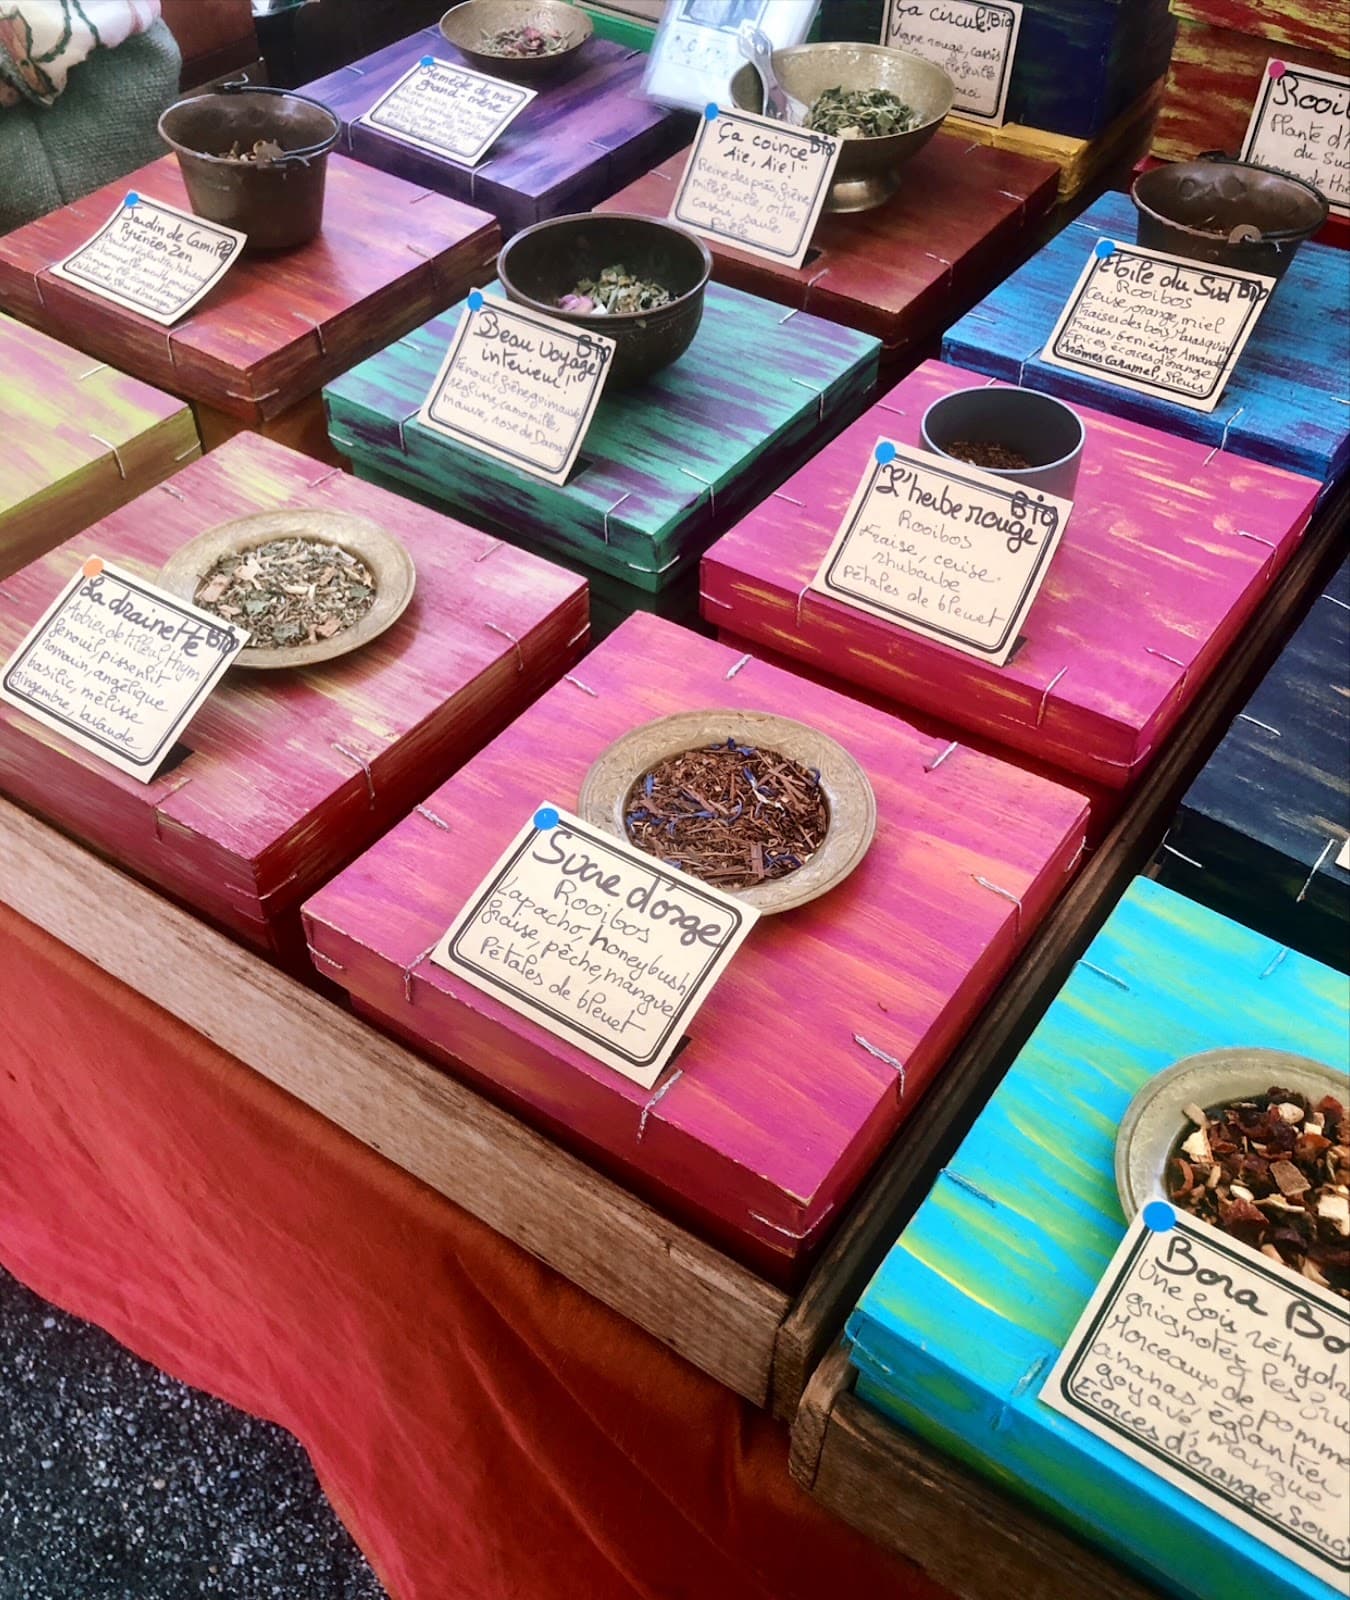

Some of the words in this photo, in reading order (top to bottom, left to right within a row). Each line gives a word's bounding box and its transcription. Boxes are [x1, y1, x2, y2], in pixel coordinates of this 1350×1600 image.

[991, 11, 1014, 28] Bio
[474, 83, 491, 98] de
[752, 136, 808, 162] coince
[1294, 145, 1318, 161] du
[166, 219, 184, 242] de
[168, 244, 193, 262] Zen
[1116, 280, 1193, 309] Rooibos
[1160, 266, 1189, 292] du
[1194, 275, 1236, 303] Sud
[1120, 314, 1141, 329] des
[1182, 317, 1225, 334] miel
[539, 340, 597, 381] Voyage
[576, 334, 611, 363] Bio
[1010, 490, 1059, 527] Bio
[898, 510, 972, 550] Rooibos
[80, 576, 106, 606] La
[907, 587, 928, 609] de
[938, 596, 1006, 627] bleuet
[106, 622, 124, 642] de
[532, 829, 620, 898] Sucre
[553, 879, 651, 943] Rooibos
[589, 925, 688, 996] honeybush
[549, 975, 571, 999] de
[577, 989, 646, 1034] bleuet
[1155, 1236, 1269, 1317] Bora
[1139, 1259, 1184, 1301] Une
[1187, 1293, 1237, 1334] fois
[1246, 1330, 1350, 1401] réhydr
[1108, 1314, 1218, 1391] Morceaux
[1222, 1374, 1253, 1411] de
[1262, 1362, 1301, 1402] les
[1208, 1431, 1326, 1511] mangue
